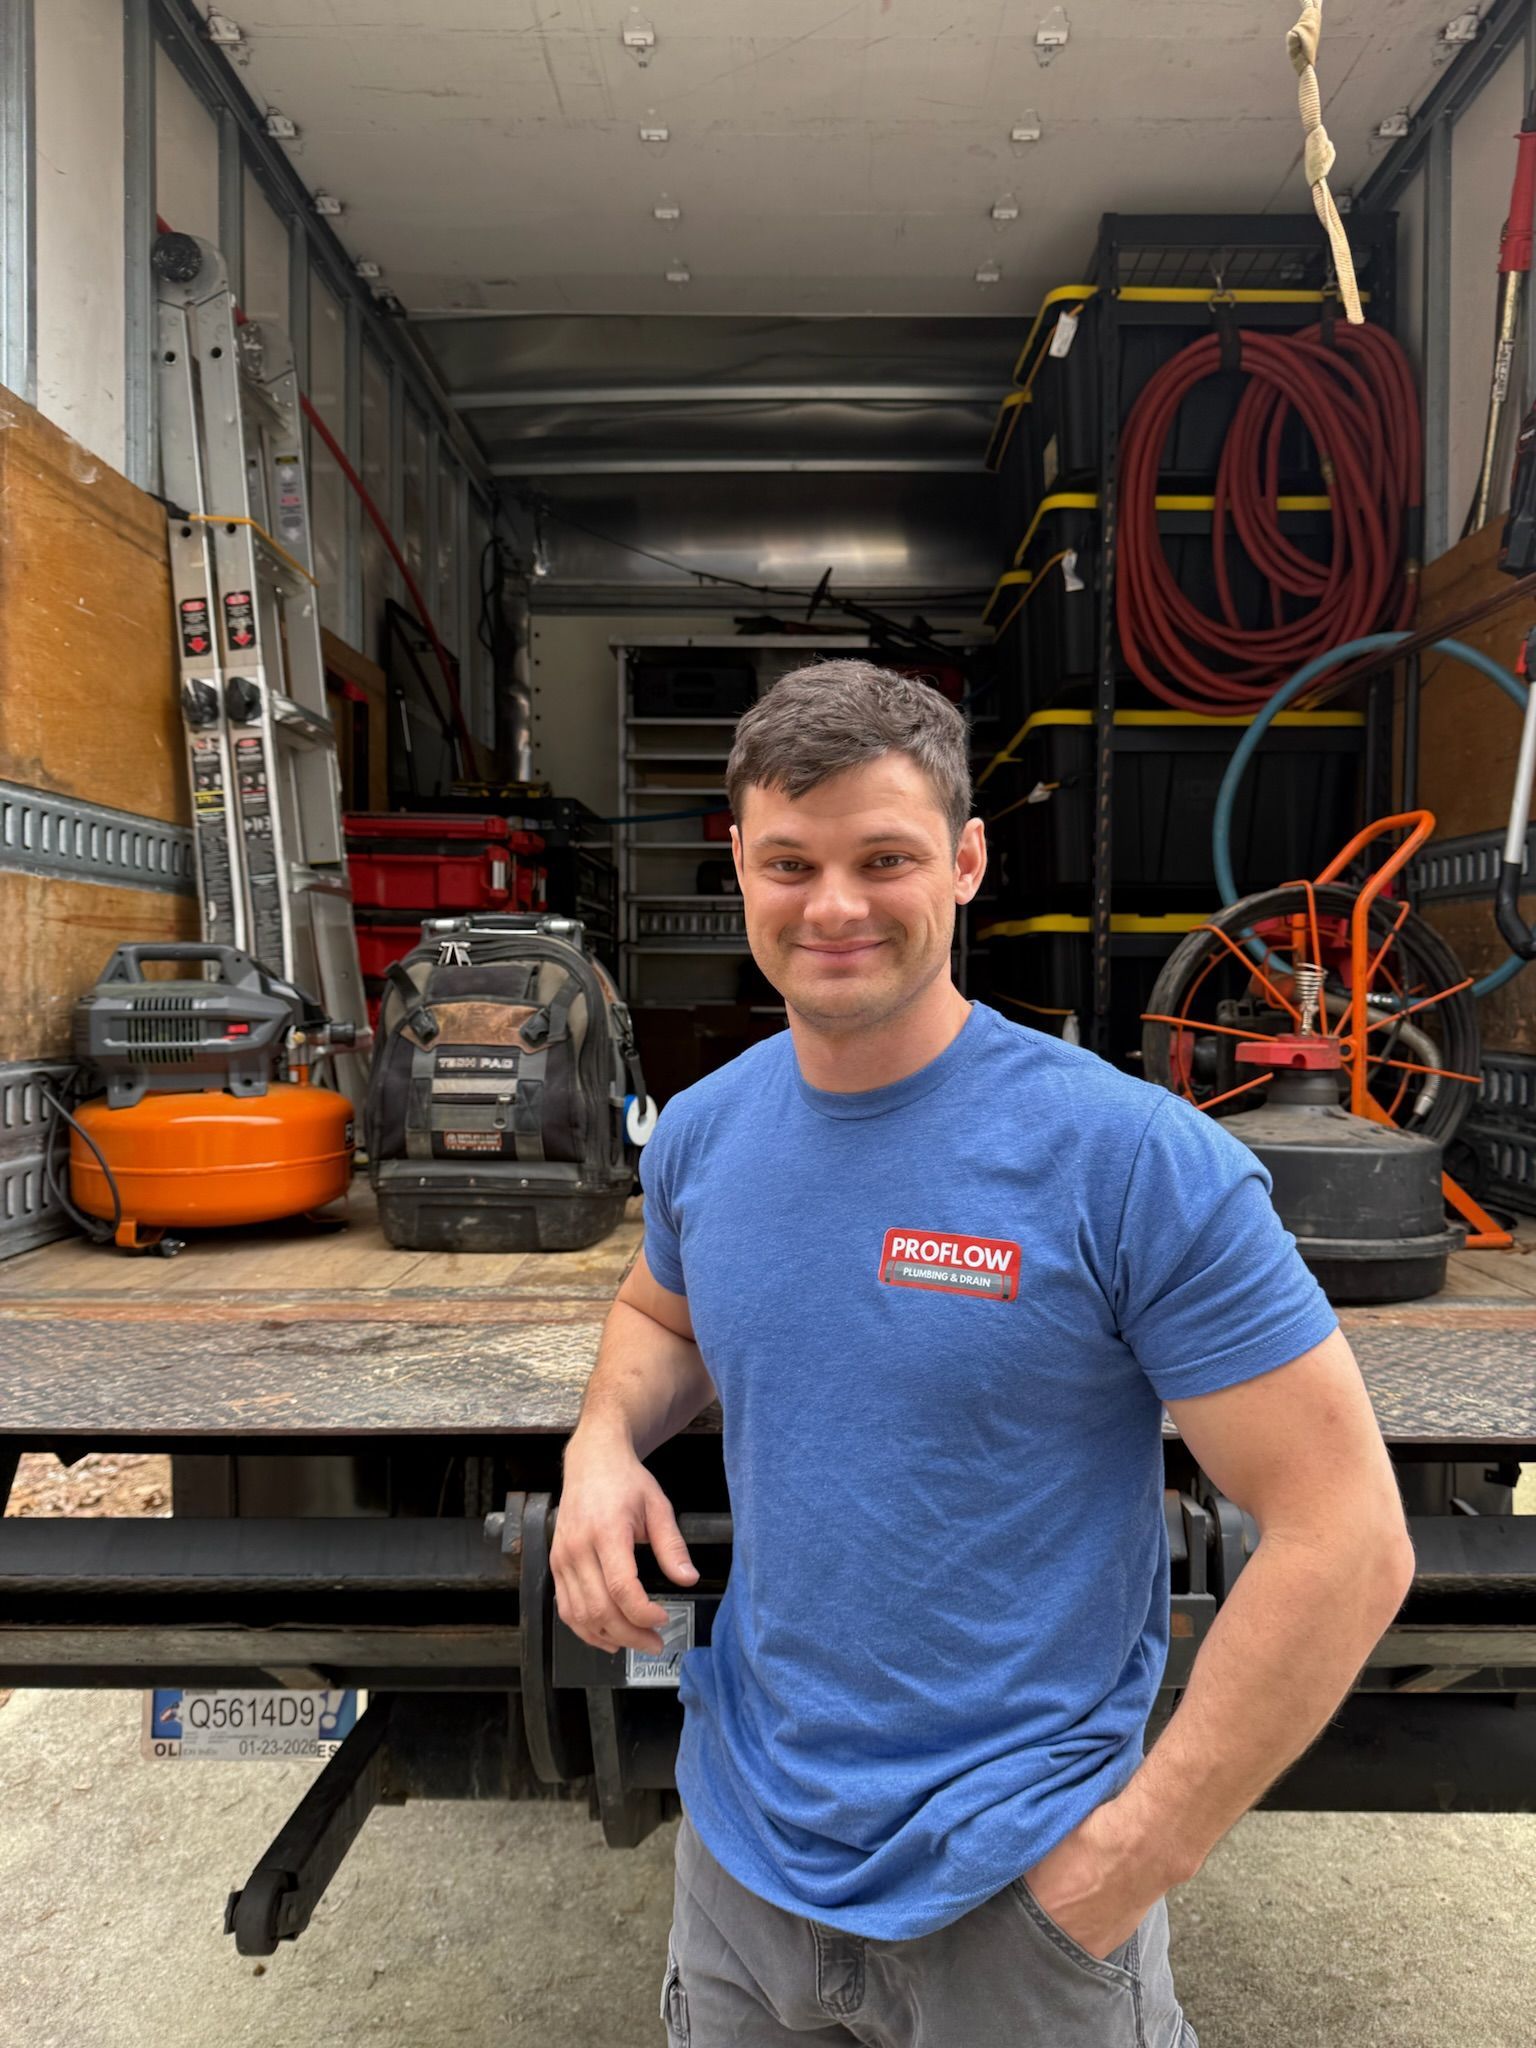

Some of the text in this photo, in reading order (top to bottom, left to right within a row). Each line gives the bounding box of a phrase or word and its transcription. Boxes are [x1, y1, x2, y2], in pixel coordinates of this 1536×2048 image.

[891, 1237, 1013, 1271] PROFLOW
[903, 1267, 991, 1288] PLUMBING & DRAIN
[190, 1697, 314, 1729] Q5614D9
[239, 1738, 318, 1756] 01-23-2026
